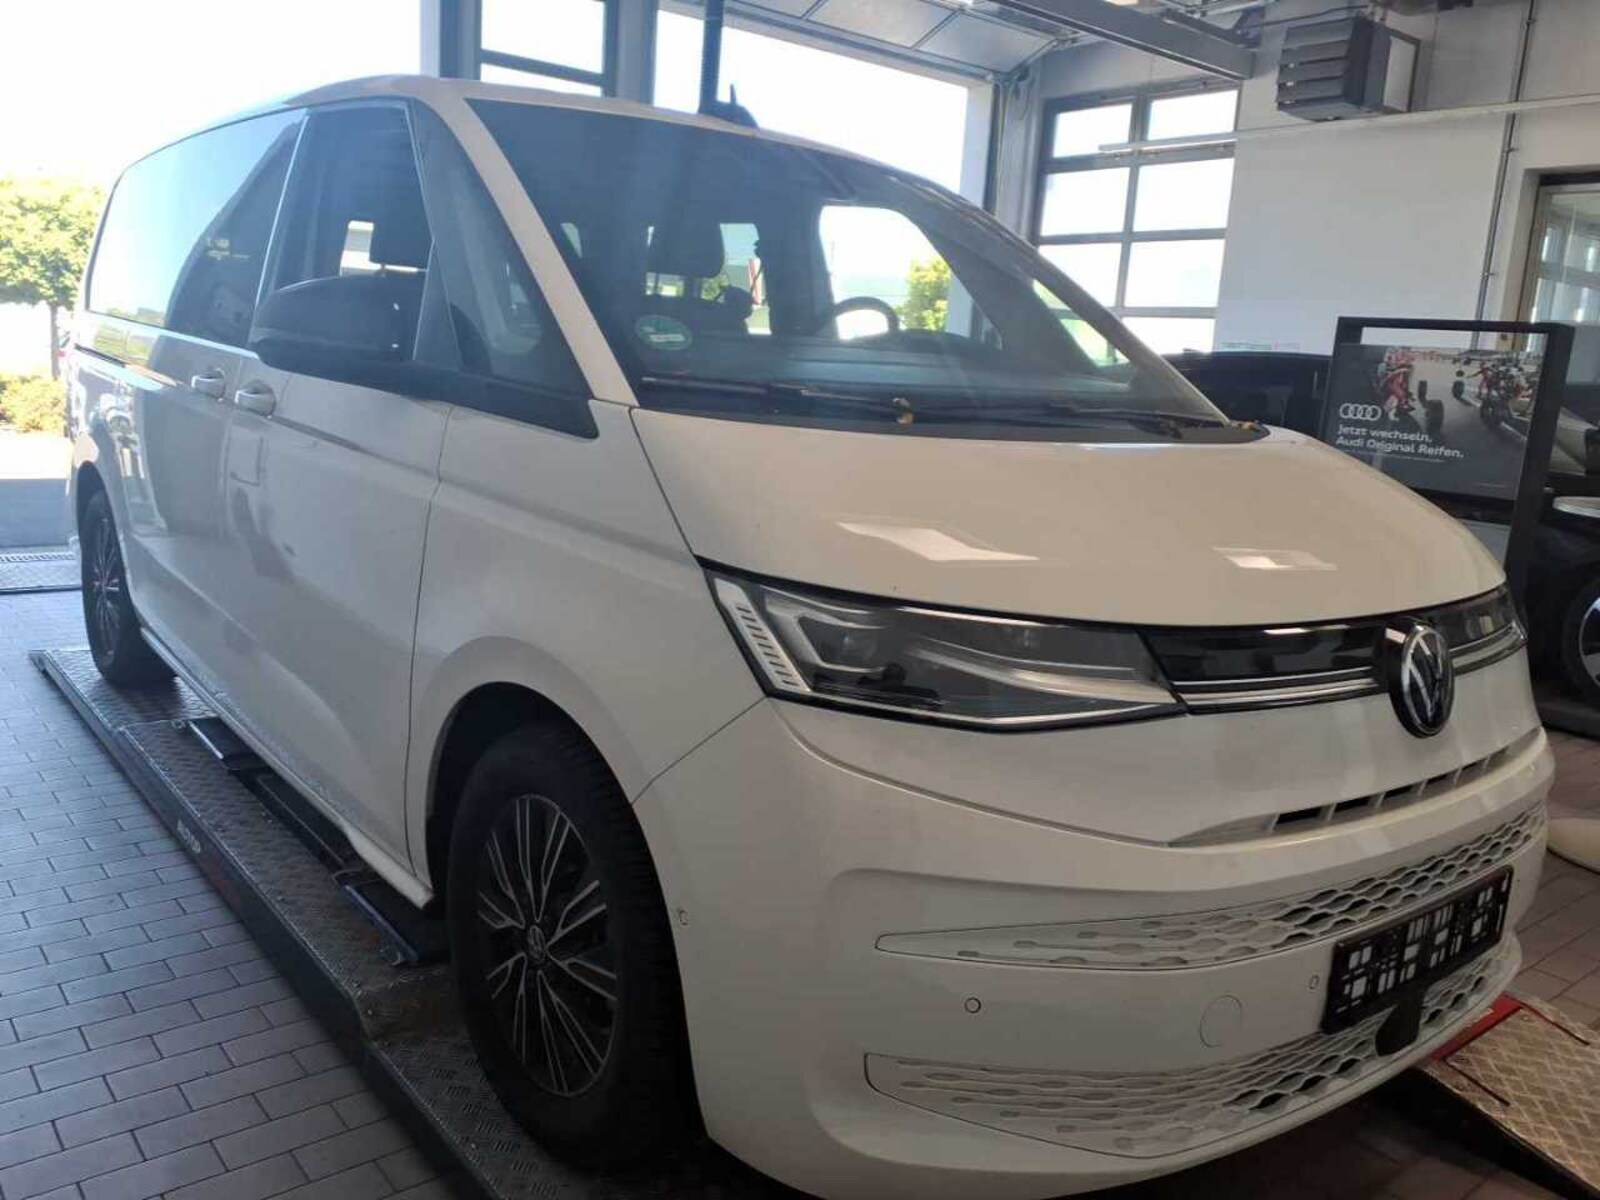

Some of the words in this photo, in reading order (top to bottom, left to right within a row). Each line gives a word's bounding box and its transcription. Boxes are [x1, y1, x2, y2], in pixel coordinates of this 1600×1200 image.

[1338, 424, 1366, 435] Jetzt
[1370, 428, 1432, 442] wechseln.
[1335, 436, 1364, 447] Audi
[1366, 439, 1415, 452] Original
[1418, 444, 1464, 458] Reifen.
